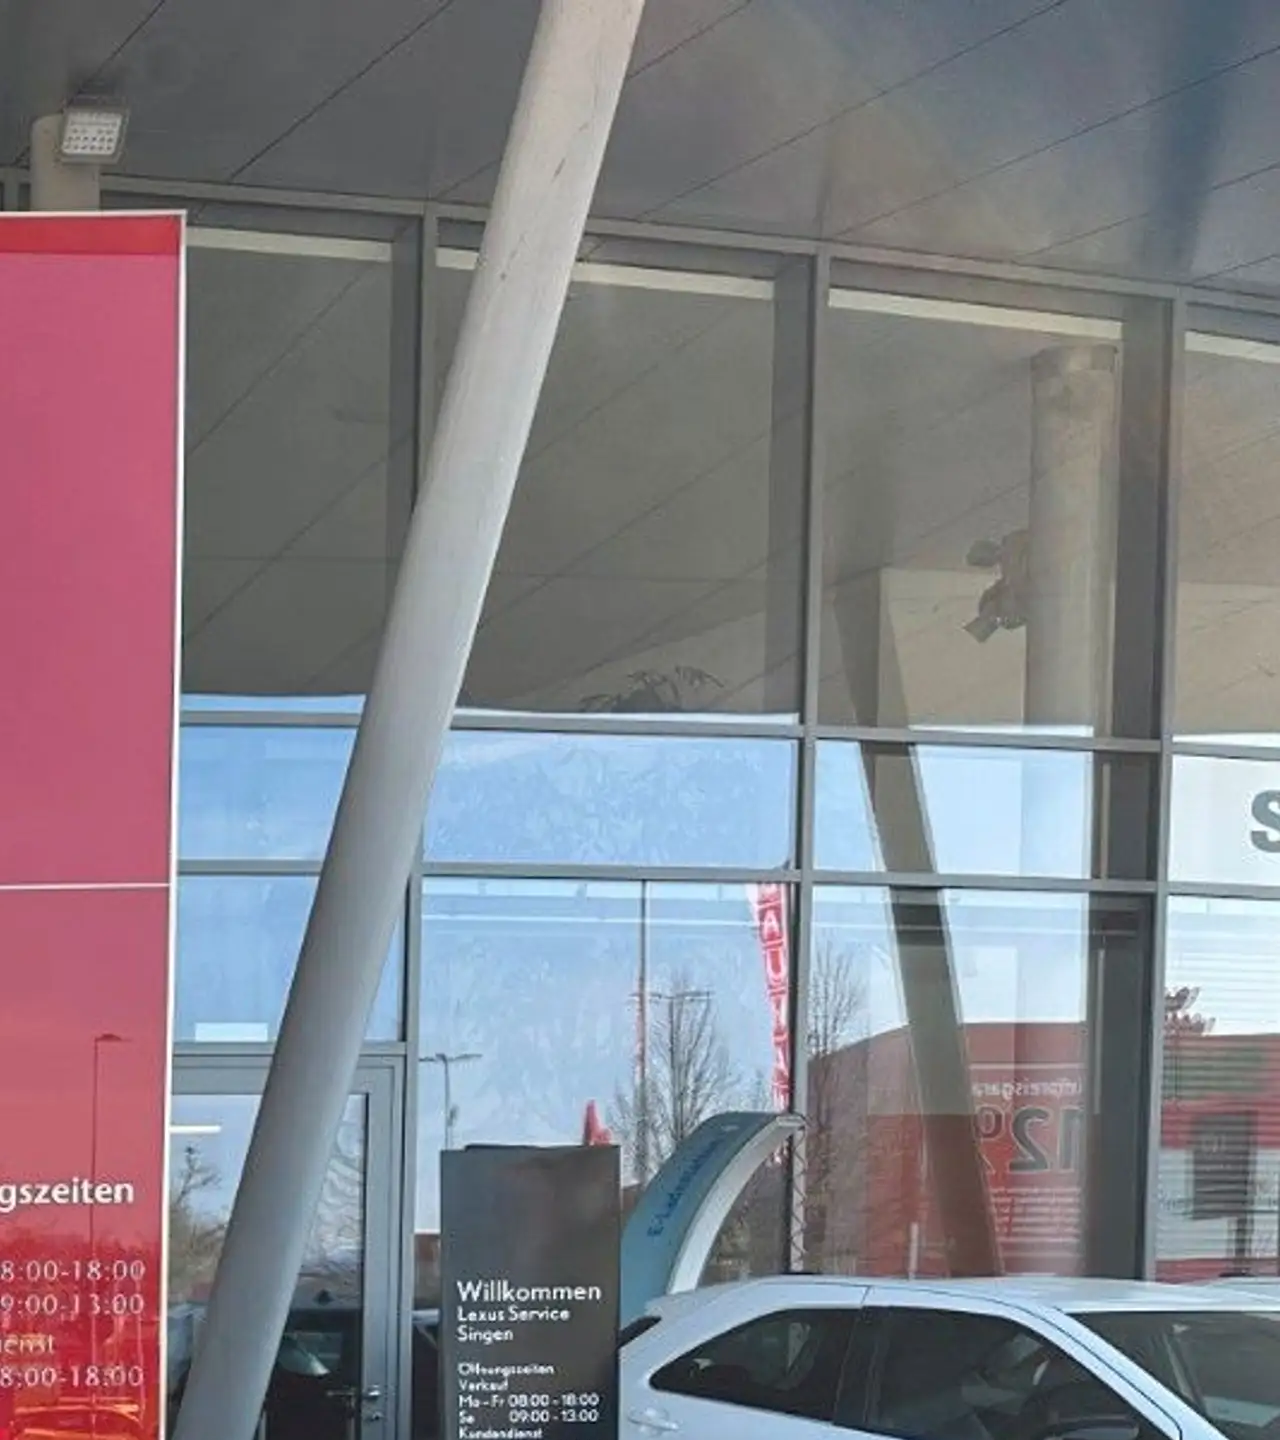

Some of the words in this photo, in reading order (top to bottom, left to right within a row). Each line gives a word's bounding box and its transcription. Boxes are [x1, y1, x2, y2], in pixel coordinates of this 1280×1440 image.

[457, 1280, 602, 1302] Willkommen
[457, 1307, 504, 1321] Lexus
[508, 1306, 571, 1321] Service
[457, 1325, 514, 1345] Singen
[458, 1379, 509, 1391] Verkauf
